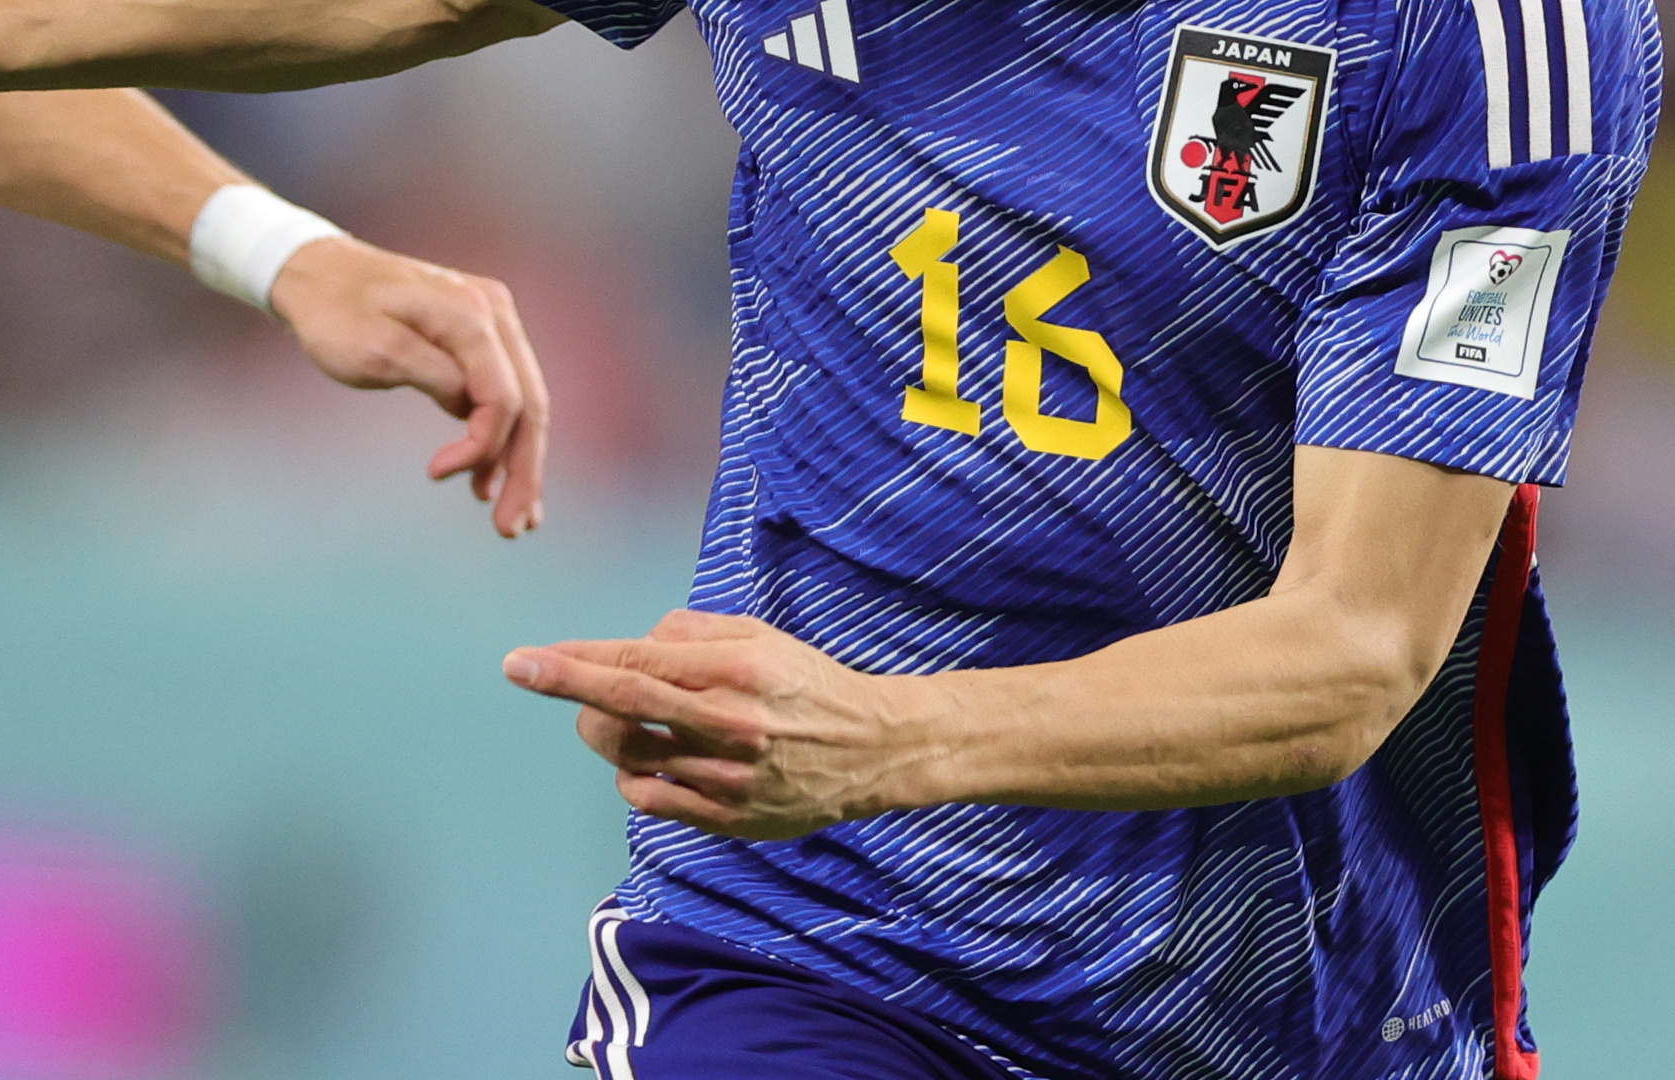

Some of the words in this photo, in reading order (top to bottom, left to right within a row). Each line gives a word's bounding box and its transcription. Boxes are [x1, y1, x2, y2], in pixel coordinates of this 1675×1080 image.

[1212, 40, 1292, 68] JAPAN
[1188, 174, 1260, 212] JFA
[1466, 289, 1507, 306] FOOTBALL
[1458, 304, 1504, 326] UNITES
[889, 208, 1132, 460] 16
[1466, 324, 1504, 347] World
[1458, 345, 1484, 361] FIFA
